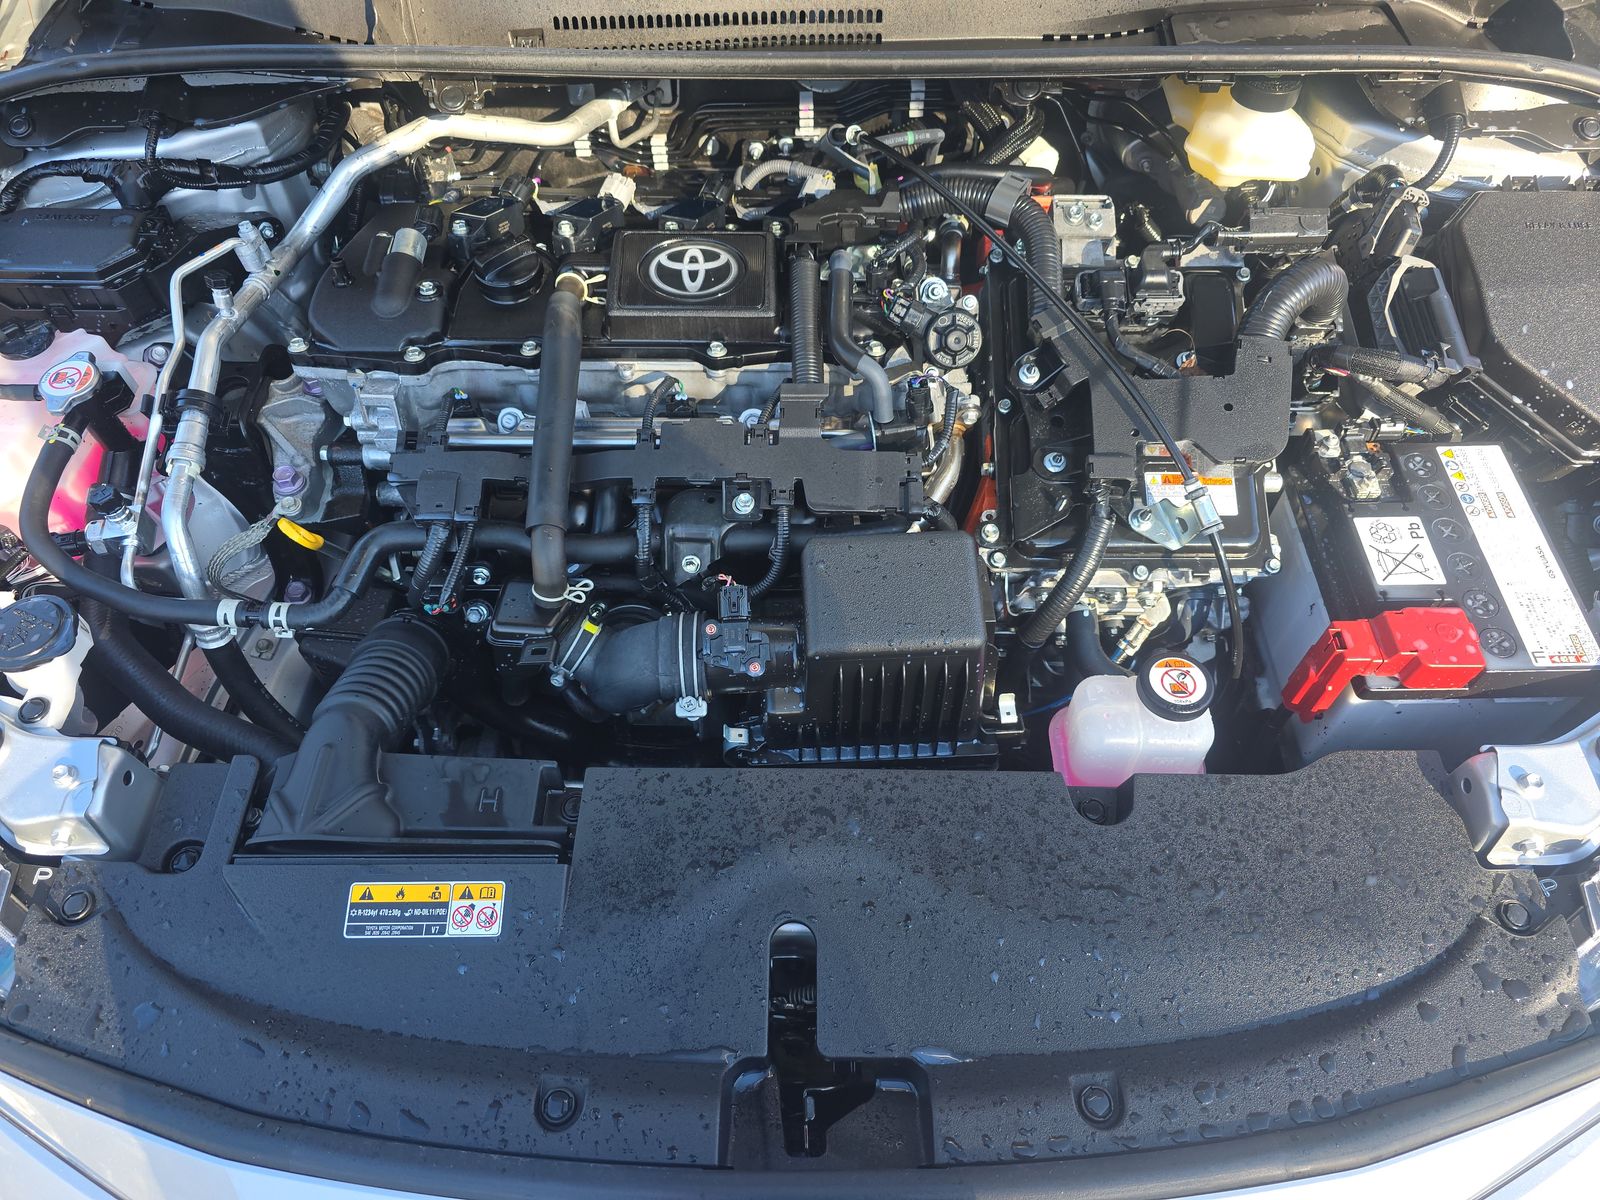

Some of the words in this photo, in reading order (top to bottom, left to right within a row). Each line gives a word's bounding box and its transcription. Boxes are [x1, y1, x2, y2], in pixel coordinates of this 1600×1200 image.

[1408, 522, 1424, 539] Pb
[479, 789, 500, 812] H
[33, 868, 53, 885] P
[431, 926, 440, 934] V7
